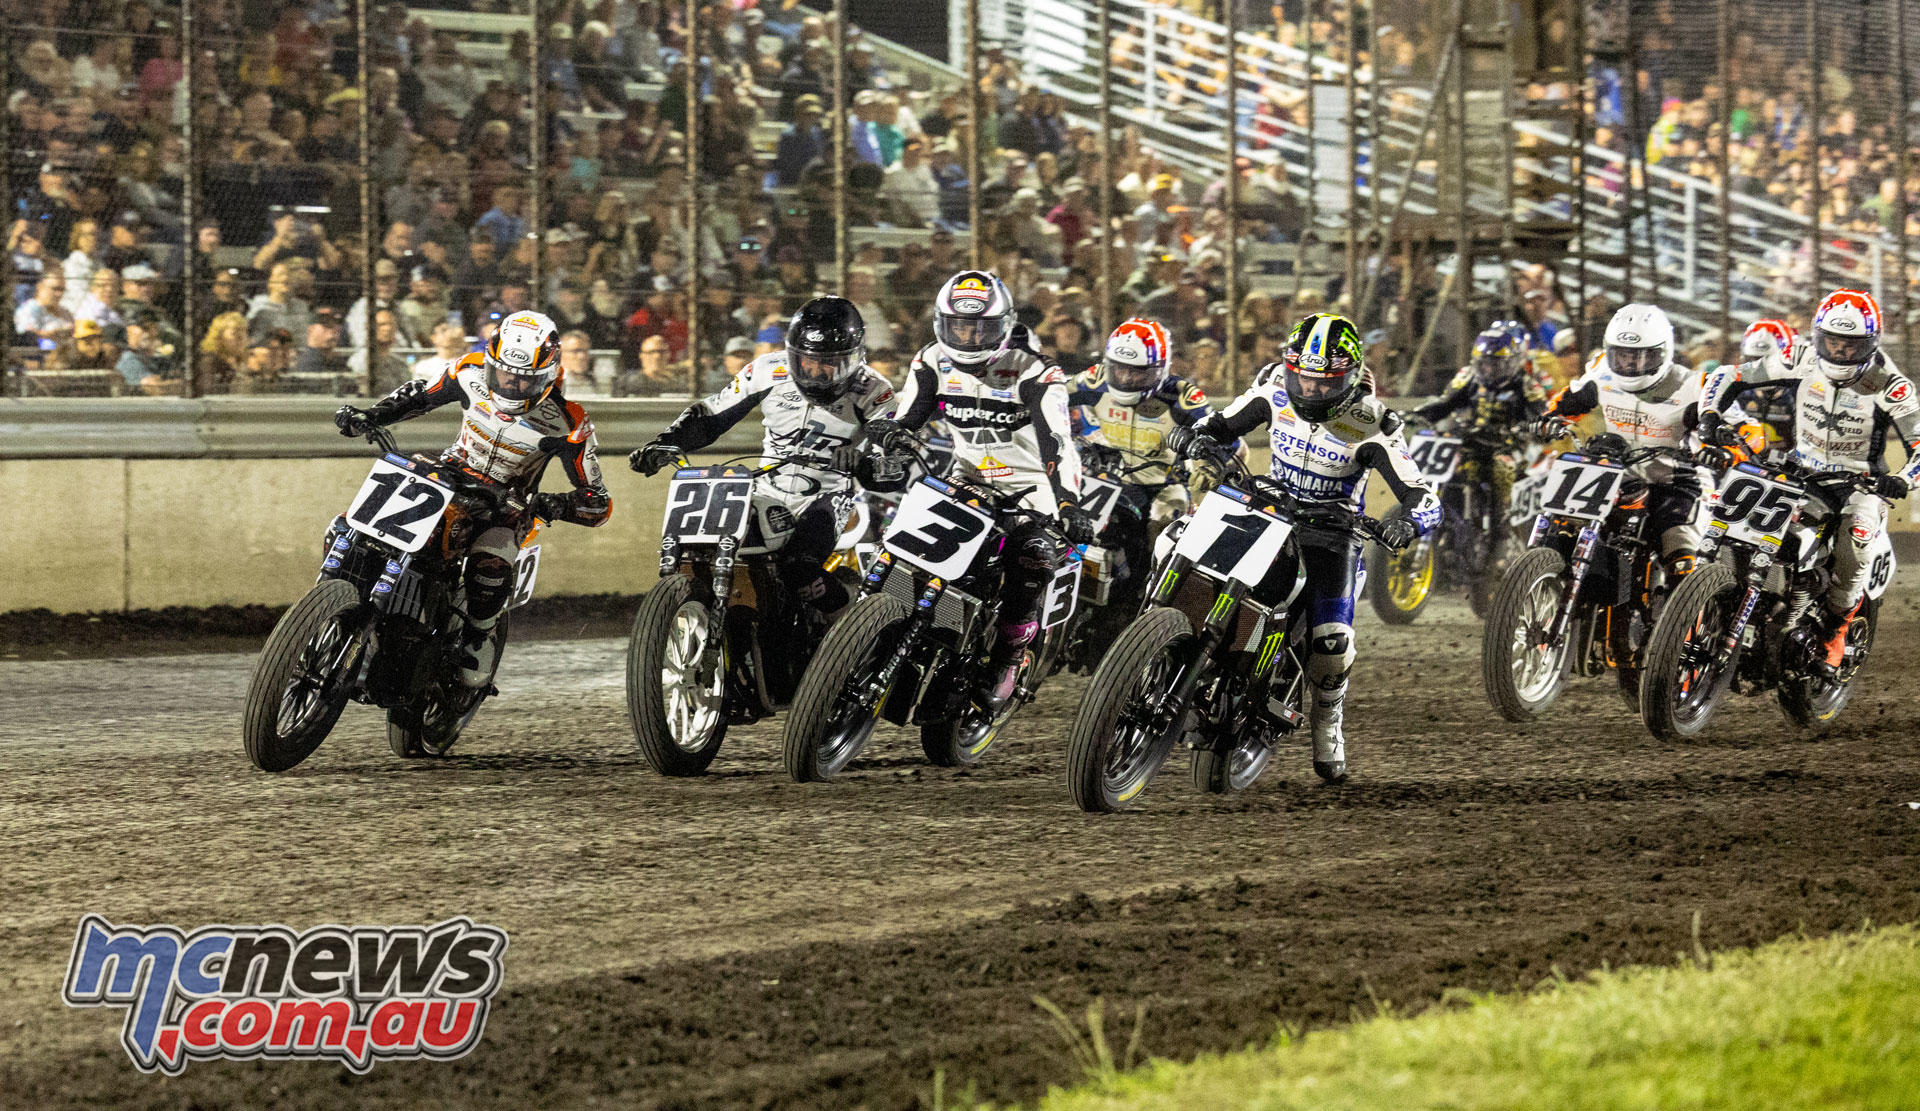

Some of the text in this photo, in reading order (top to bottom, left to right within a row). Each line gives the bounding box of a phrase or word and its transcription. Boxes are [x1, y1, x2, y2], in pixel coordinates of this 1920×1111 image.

[956, 300, 981, 310] Arai
[1617, 333, 1639, 342] Arai
[503, 349, 529, 362] Arai
[1301, 354, 1324, 365] Arai
[470, 382, 490, 399] Arai
[945, 402, 1030, 425] Super.com
[1352, 409, 1374, 423] Arai
[1272, 428, 1351, 463] ESTENSON
[1410, 440, 1457, 475] 49
[1283, 466, 1343, 492] YAMAHA
[1543, 466, 1619, 516] 14
[351, 472, 445, 544] 12
[666, 482, 750, 535] 26
[1712, 477, 1801, 533] 95
[886, 499, 984, 563] 3
[1196, 513, 1272, 576] 1
[1869, 551, 1891, 590] 95
[1046, 571, 1076, 627] 3
